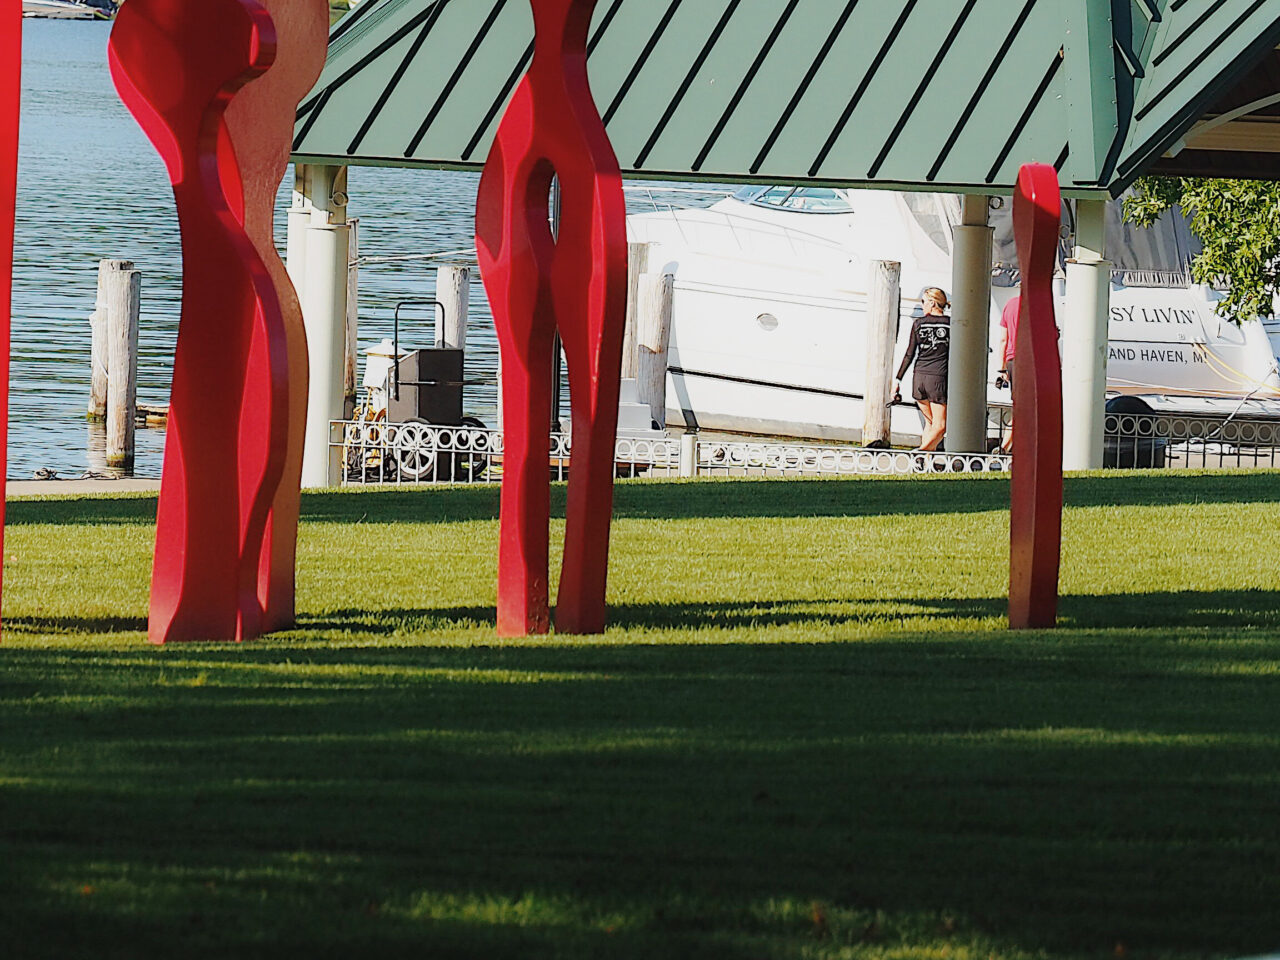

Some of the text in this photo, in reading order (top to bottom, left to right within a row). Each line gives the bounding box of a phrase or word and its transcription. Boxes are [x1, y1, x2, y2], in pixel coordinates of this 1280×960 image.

[1110, 305, 1195, 324] SY LIVIN'
[1108, 348, 1136, 361] AND
[1141, 349, 1188, 365] HAVEN,
